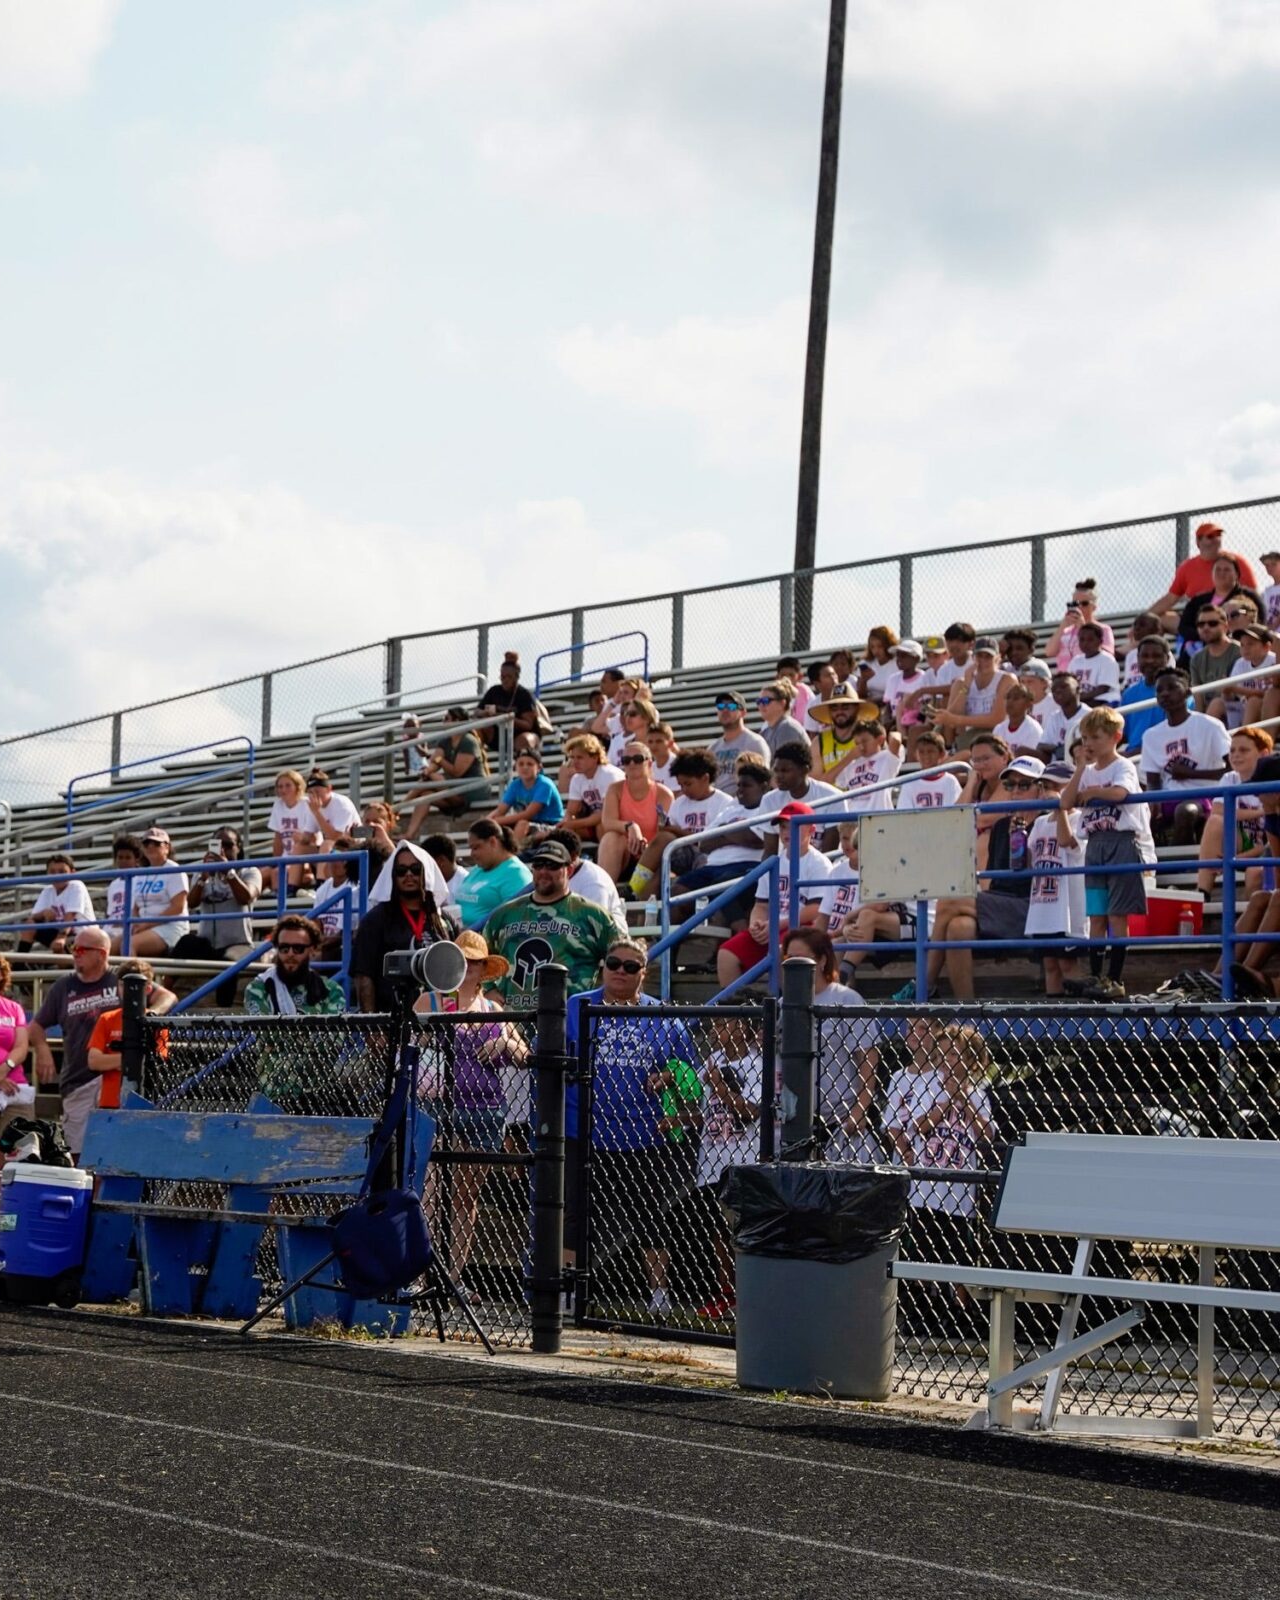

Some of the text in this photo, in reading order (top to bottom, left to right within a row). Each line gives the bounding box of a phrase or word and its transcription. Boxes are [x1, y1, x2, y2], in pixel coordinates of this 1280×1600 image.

[505, 920, 581, 937] TREASURE
[102, 986, 118, 998] LV
[505, 993, 539, 1007] COAS
